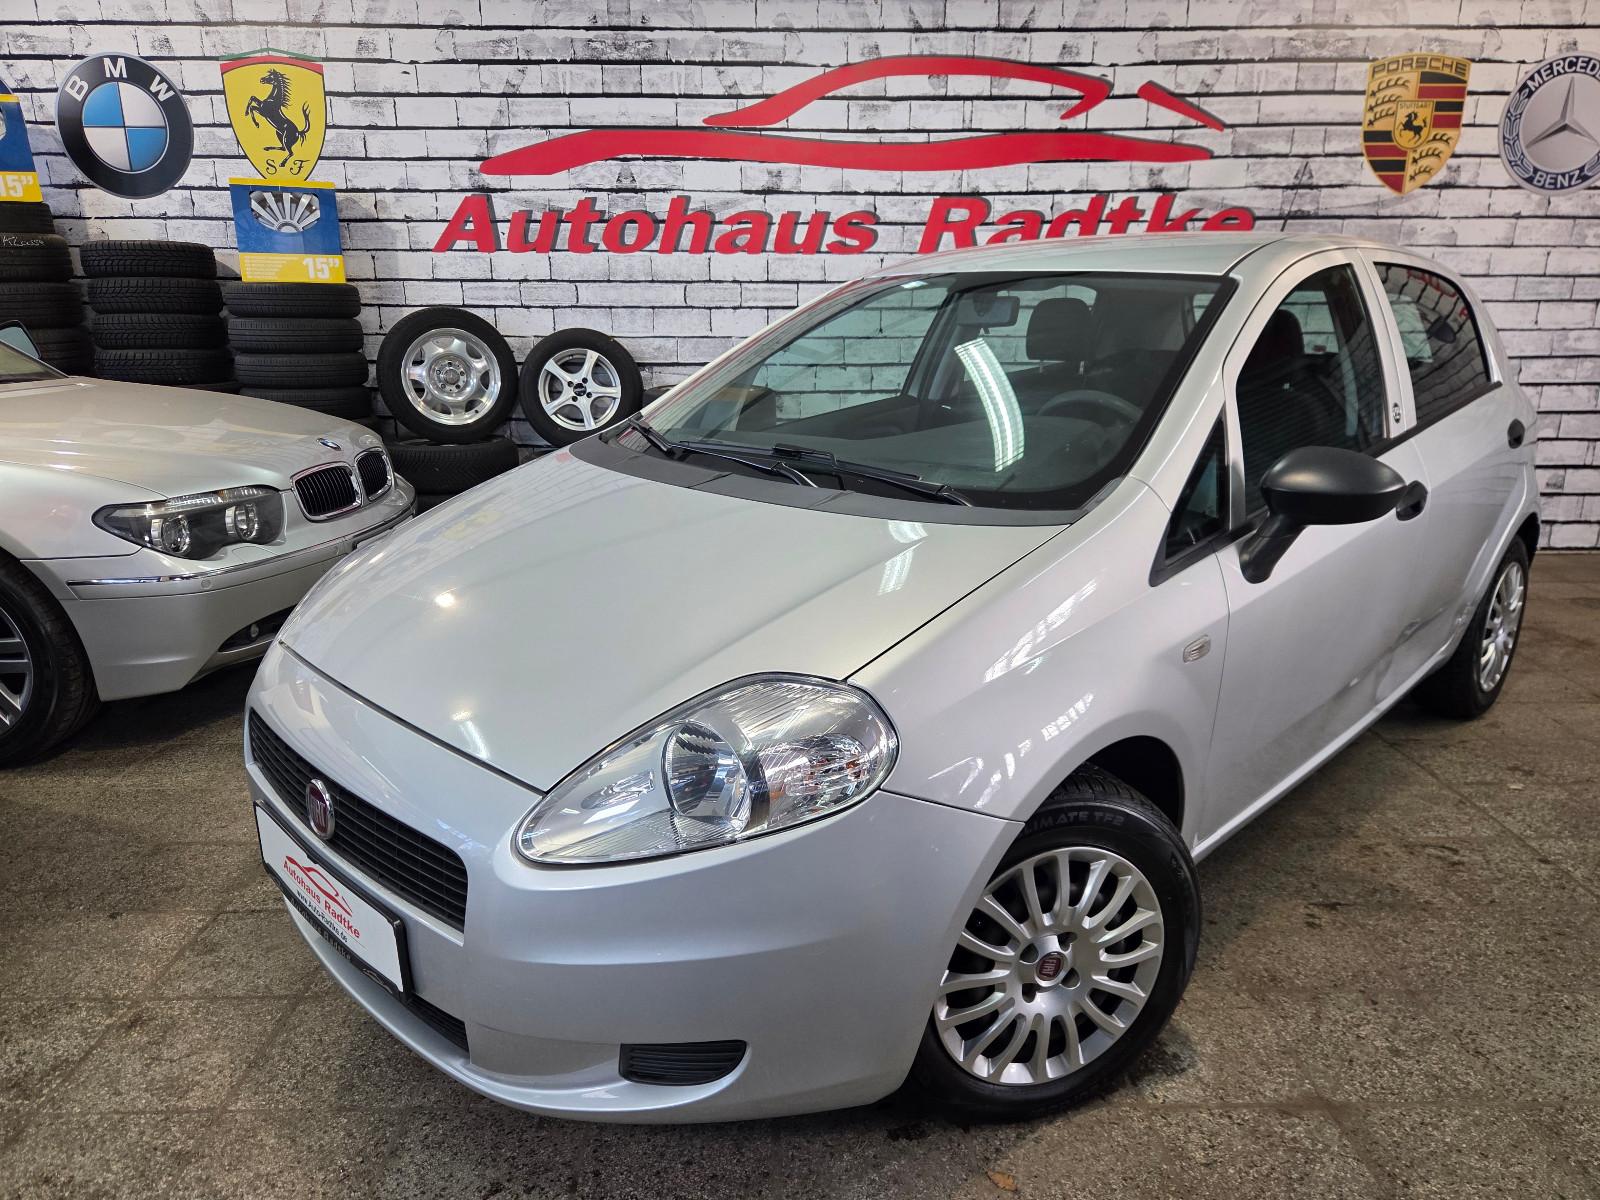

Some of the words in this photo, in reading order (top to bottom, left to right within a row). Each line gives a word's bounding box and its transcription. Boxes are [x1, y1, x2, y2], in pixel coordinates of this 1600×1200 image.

[65, 57, 176, 103] BMW
[1371, 57, 1469, 79] PORSCHE
[1532, 169, 1583, 190] BENZ
[432, 193, 878, 255] Autohaus
[283, 860, 321, 904] Autohaus
[323, 900, 361, 939] Radtke
